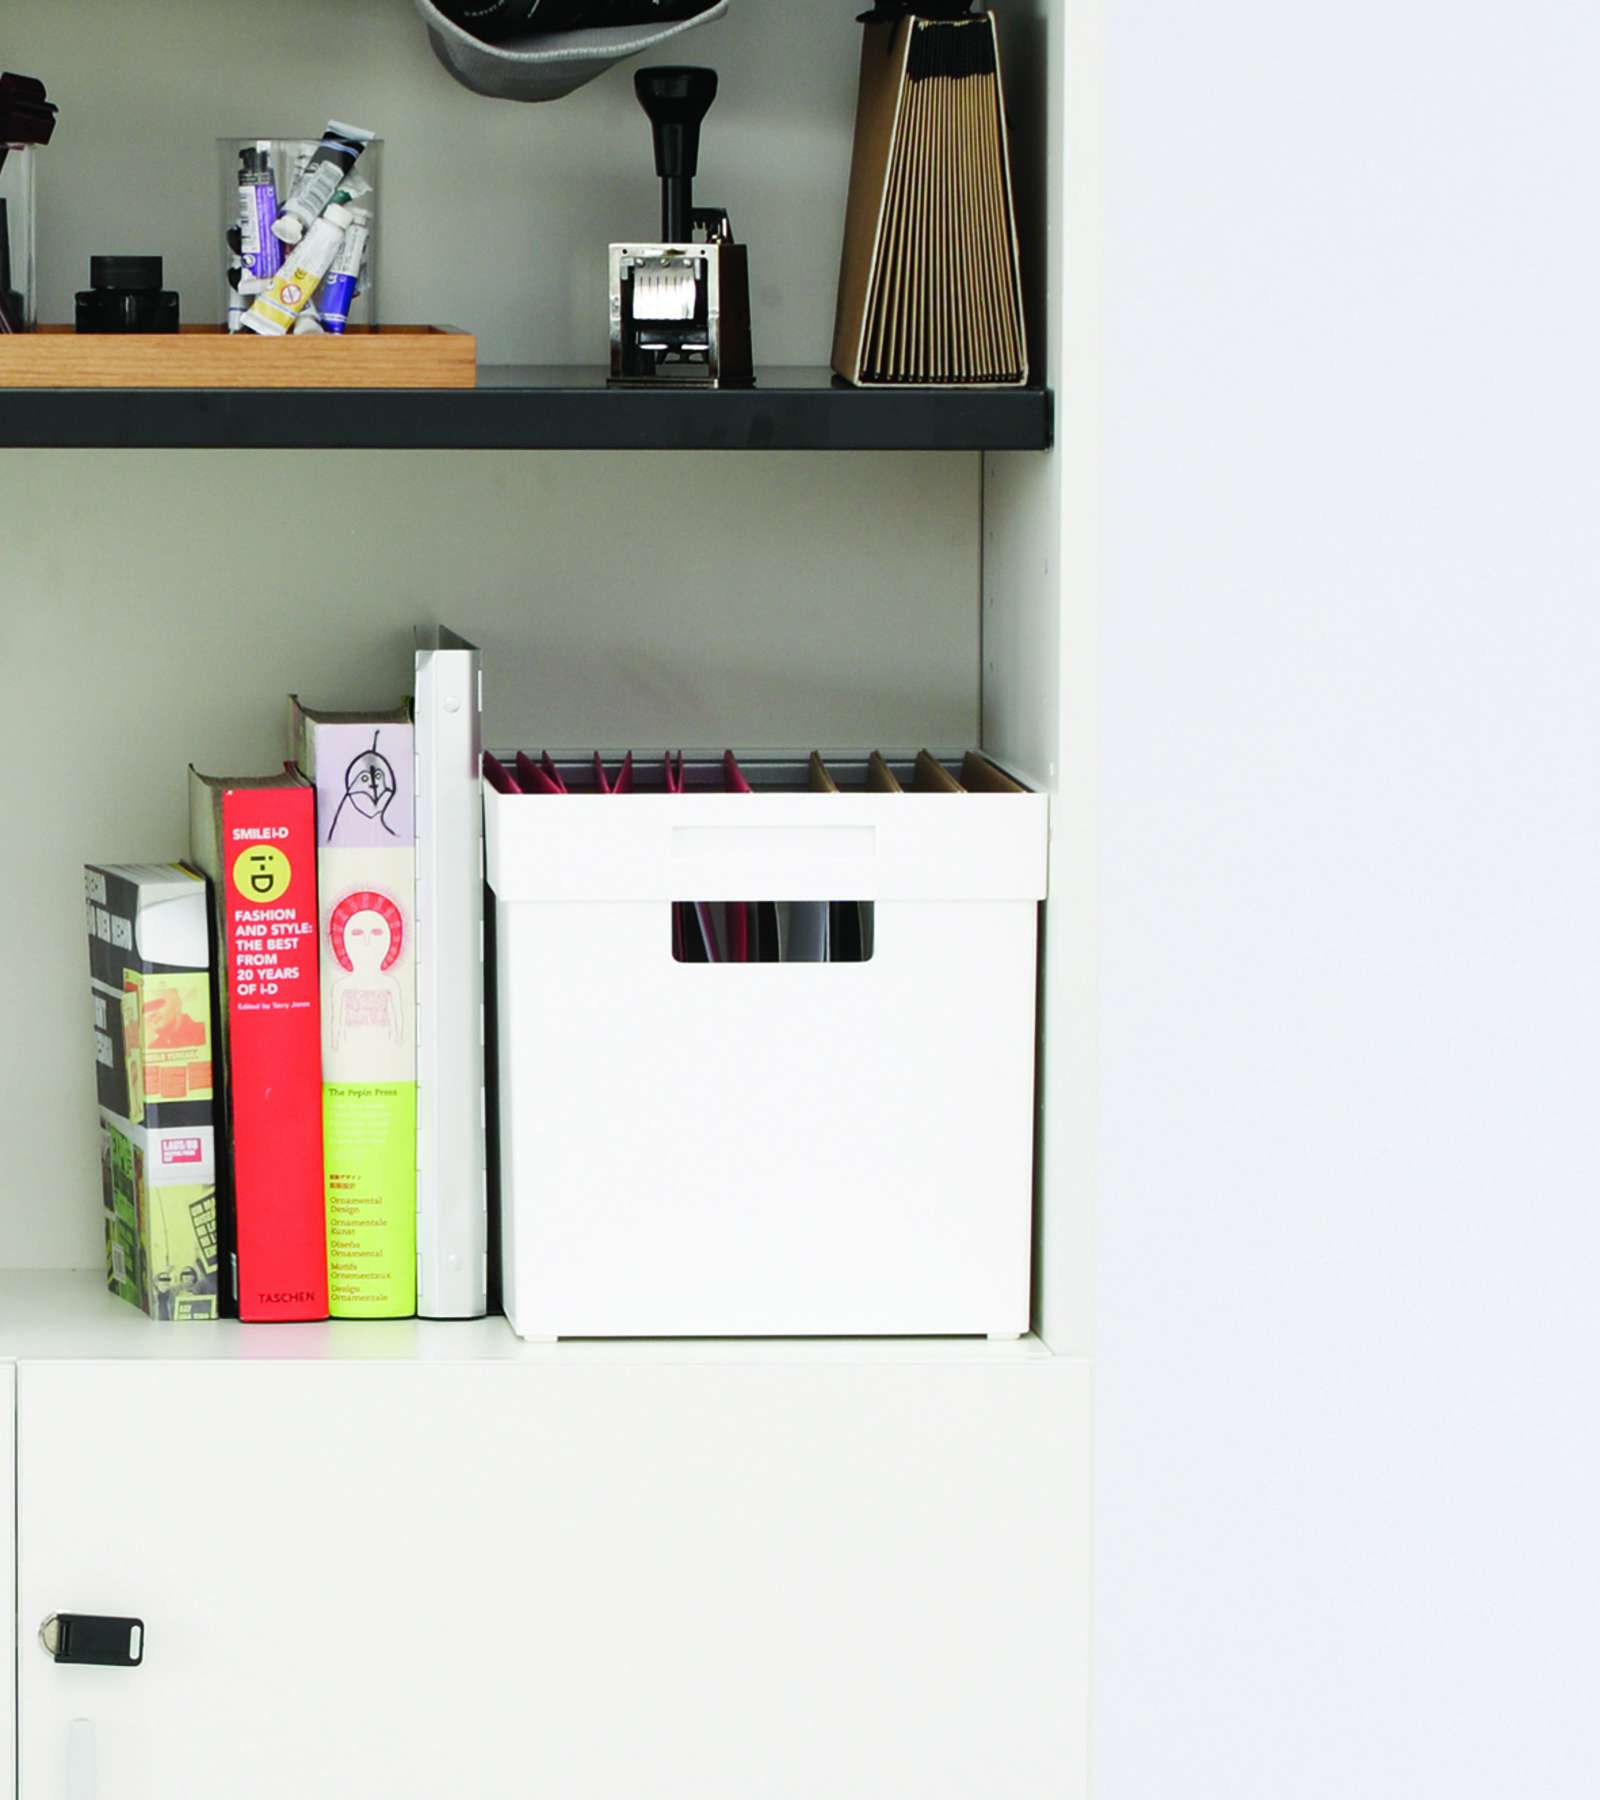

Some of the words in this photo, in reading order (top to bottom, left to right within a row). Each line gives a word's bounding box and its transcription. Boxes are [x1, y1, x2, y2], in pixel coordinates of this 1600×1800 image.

[232, 828, 270, 840] SMILE
[272, 827, 289, 839] i-D
[235, 908, 296, 922] FASHION
[235, 924, 267, 936] AND
[270, 922, 313, 935] STYLE:
[236, 939, 263, 951] THE
[267, 938, 298, 950] BEST
[236, 953, 277, 966] FROM
[237, 969, 253, 981] 20
[257, 967, 299, 980] YEARS
[237, 984, 256, 995] OF
[260, 983, 278, 995] i-D
[237, 1002, 260, 1010] Edited
[261, 1003, 271, 1011] by
[328, 1088, 345, 1096] The
[348, 1088, 372, 1098] Pepin
[374, 1088, 398, 1096] Press
[330, 1196, 383, 1205] Ornamental
[330, 1205, 360, 1215] Design
[330, 1218, 388, 1227] Ornamentale
[330, 1227, 356, 1236] Kunst
[330, 1249, 383, 1258] Ornamental
[331, 1284, 361, 1294] Design
[257, 1290, 316, 1304] TASCHEN
[330, 1293, 389, 1302] Ornamentale
